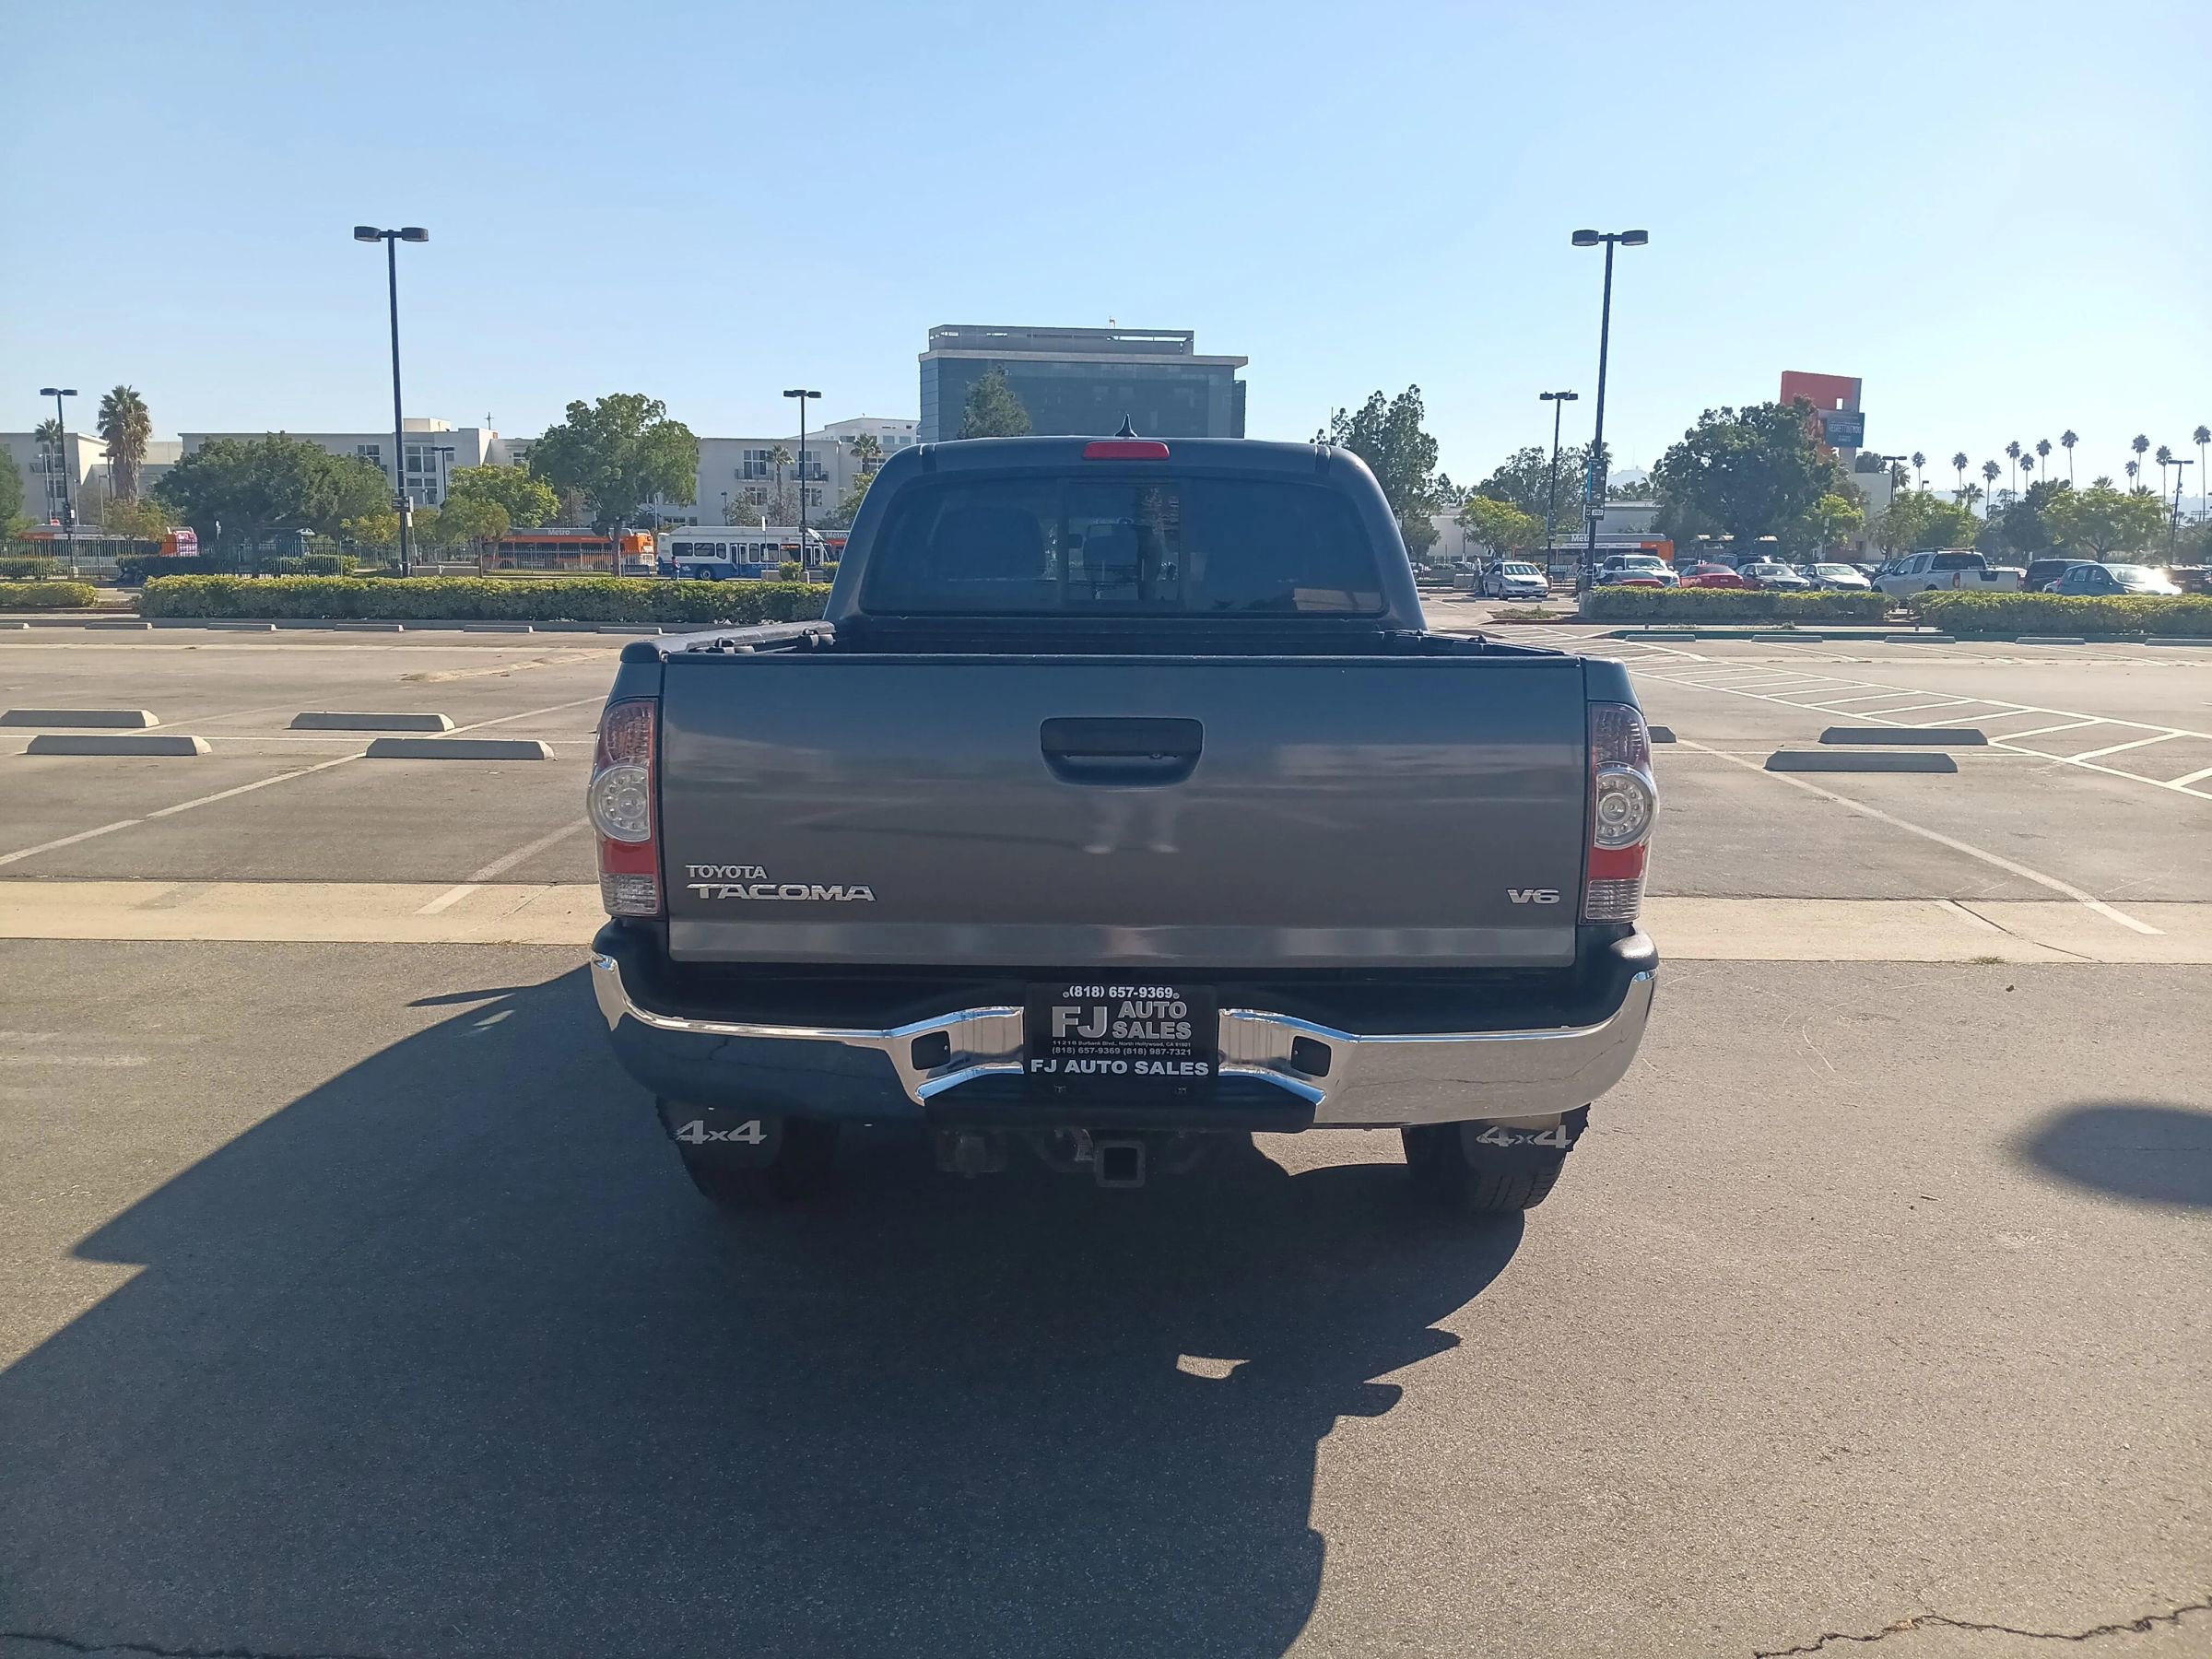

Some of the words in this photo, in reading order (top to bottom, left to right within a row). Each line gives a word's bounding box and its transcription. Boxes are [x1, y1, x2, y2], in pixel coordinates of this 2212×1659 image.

[686, 865, 768, 879] TOYOTA
[687, 883, 876, 901] TACOMA
[1507, 888, 1559, 903] V6
[1069, 985, 1105, 998] (818)
[1109, 986, 1173, 999] 657-9369
[1118, 1001, 1187, 1019] AUTO
[1052, 1006, 1108, 1038] FJ
[1112, 1021, 1192, 1040] SALES
[1052, 1046, 1076, 1054] (818)
[1078, 1046, 1121, 1054] 657-9369
[1124, 1047, 1147, 1055] (818)
[1030, 1059, 1057, 1073] FJ
[1065, 1060, 1128, 1075] AUTO
[1134, 1061, 1209, 1076] SALES
[676, 1120, 768, 1144] 4x4
[1476, 1124, 1572, 1148] 4x4
